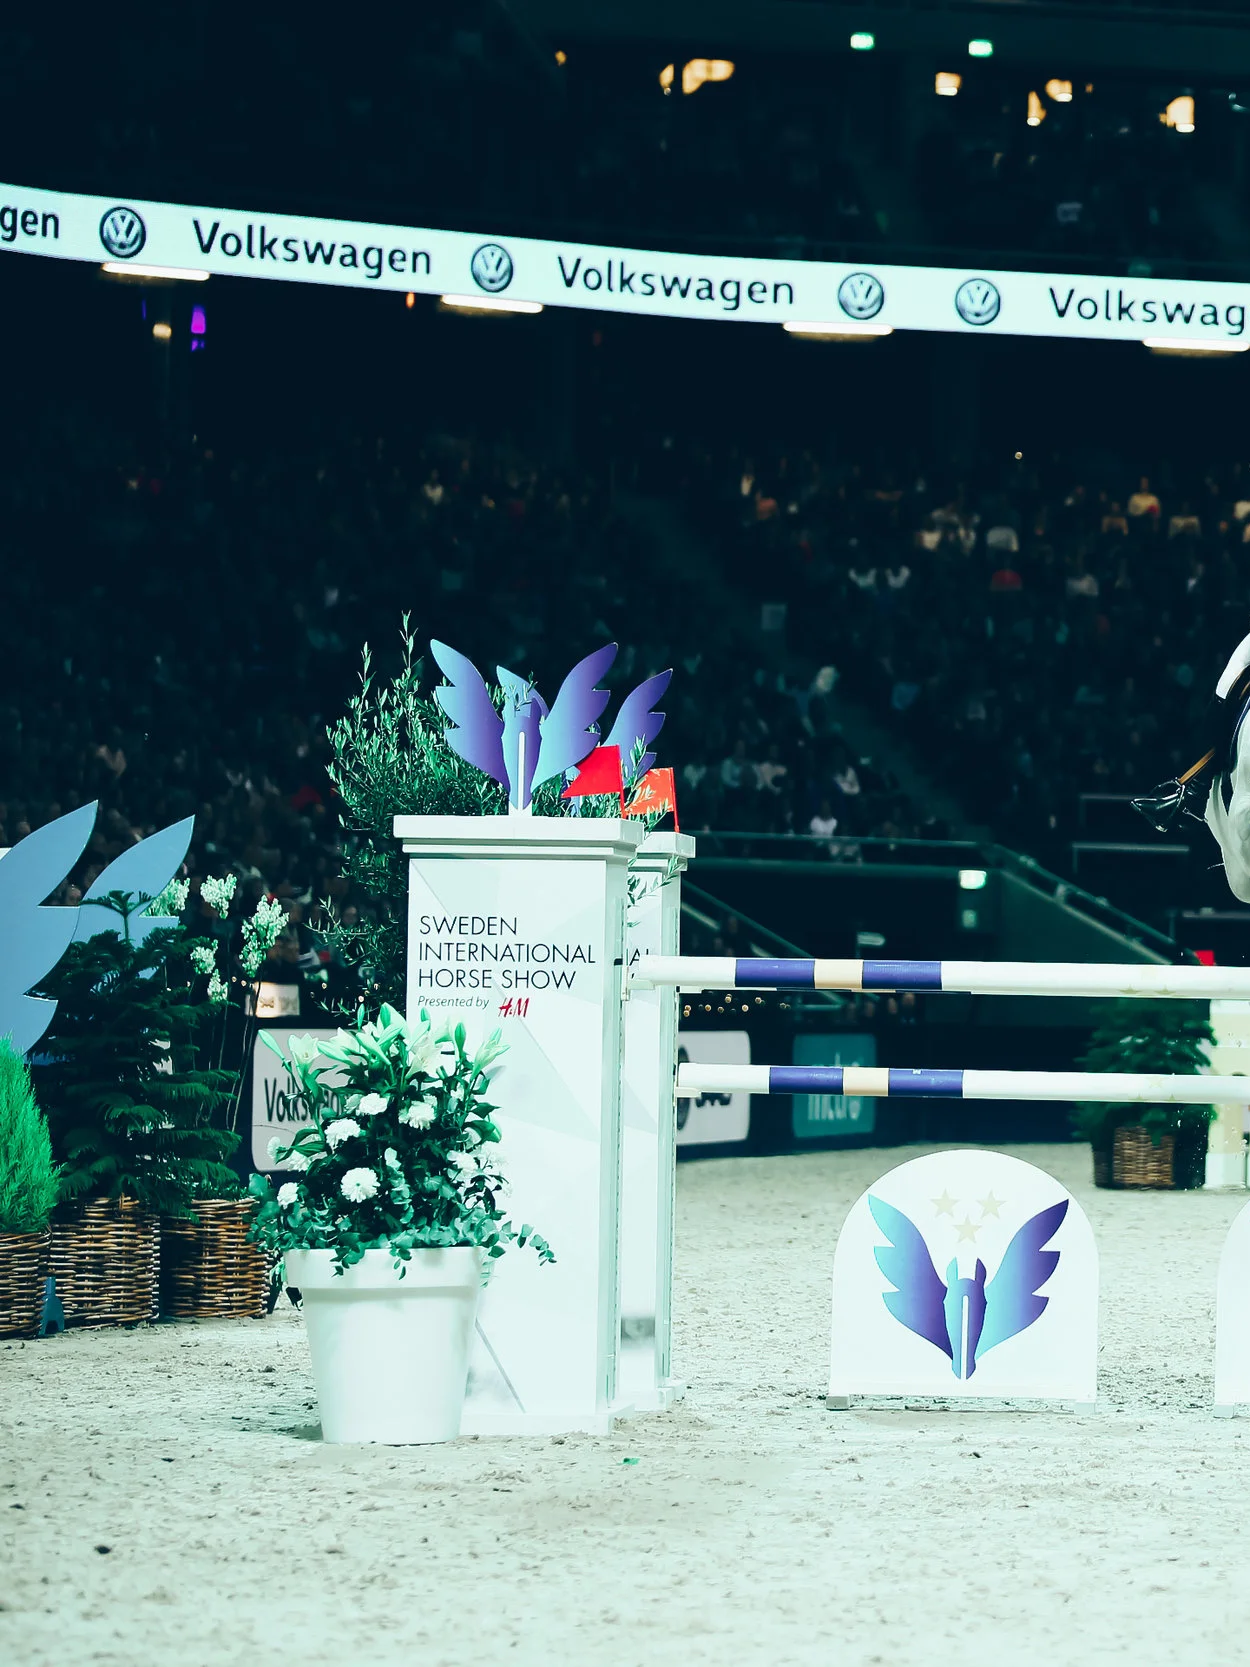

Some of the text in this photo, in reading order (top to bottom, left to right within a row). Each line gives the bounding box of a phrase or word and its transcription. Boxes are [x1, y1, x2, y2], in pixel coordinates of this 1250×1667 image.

[193, 219, 431, 280] Volkswagen
[558, 255, 794, 311] Volkswagen
[419, 915, 518, 936] SWEDEN
[419, 942, 596, 964] INTERNATIONAL
[418, 968, 577, 990] HORSE SHOW
[417, 995, 474, 1008] Presented
[475, 997, 490, 1010] by
